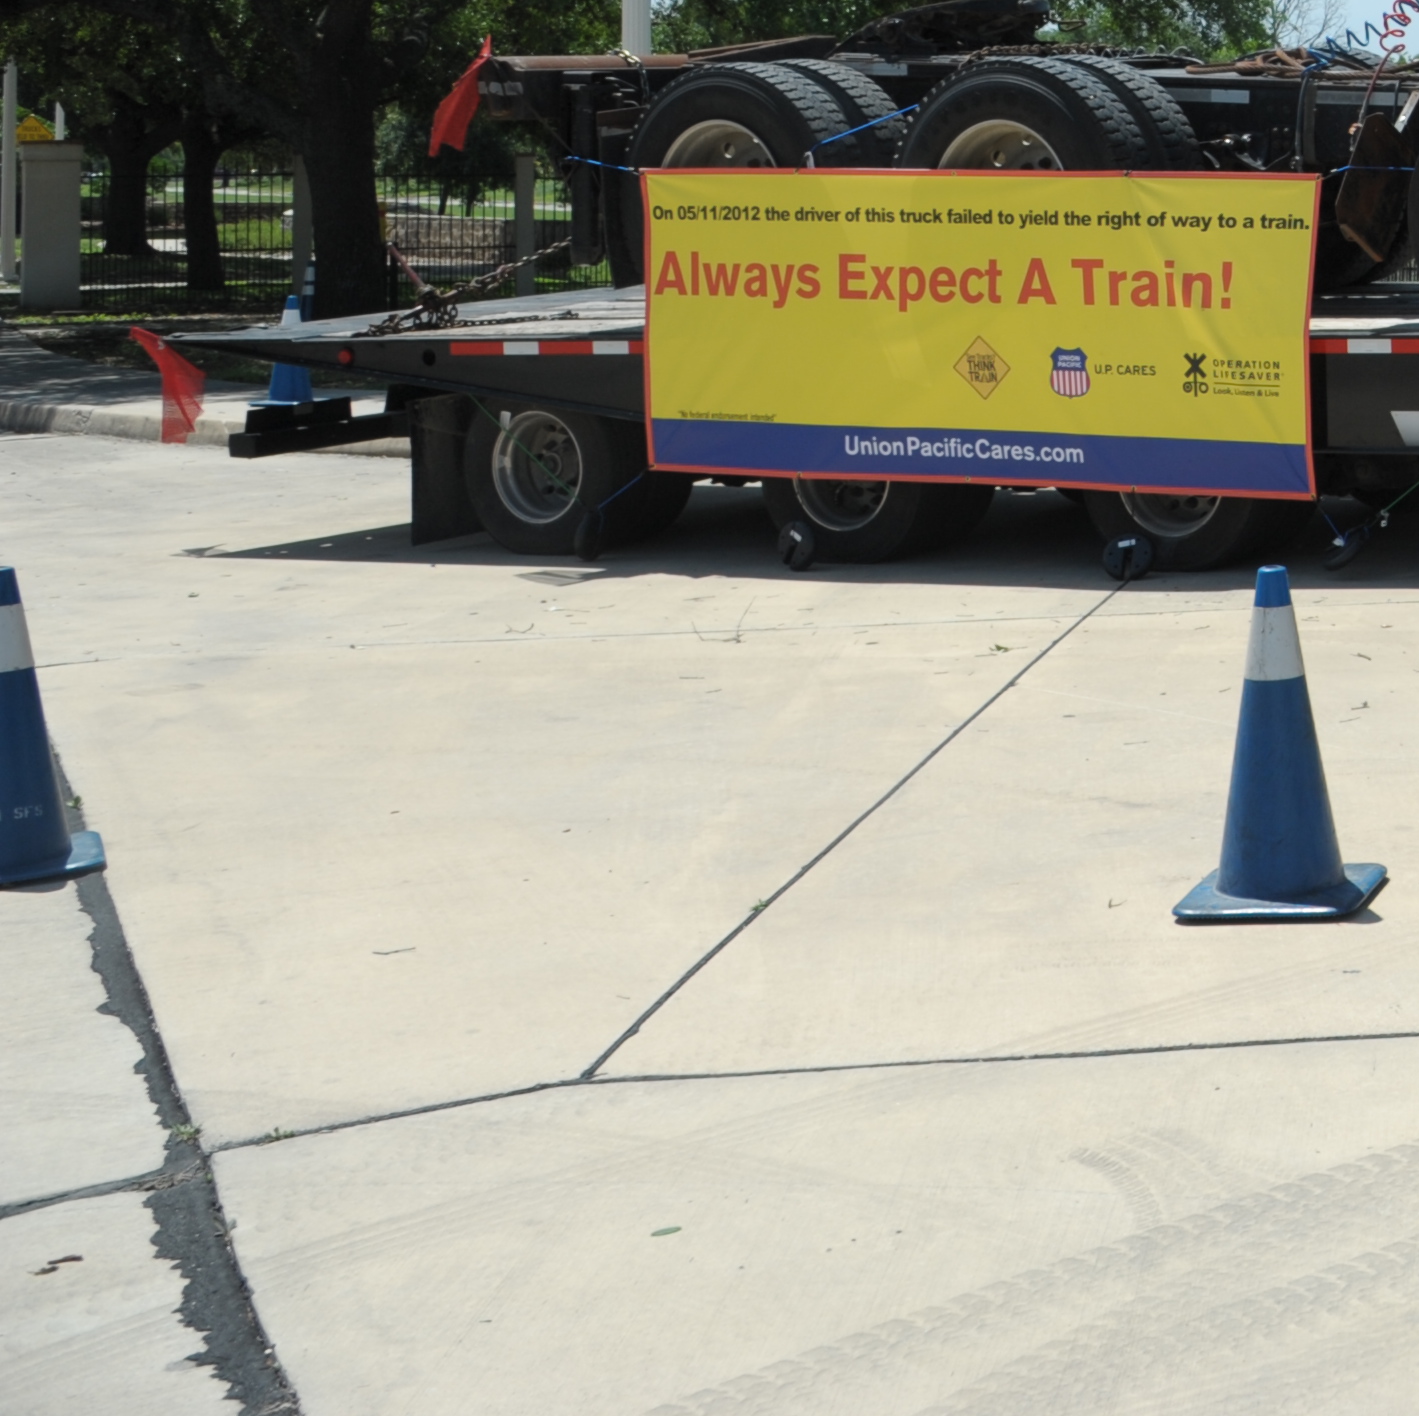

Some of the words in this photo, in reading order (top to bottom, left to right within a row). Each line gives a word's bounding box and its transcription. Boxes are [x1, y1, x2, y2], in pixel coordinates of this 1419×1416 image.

[653, 206, 673, 221] On
[677, 206, 761, 221] 05/11/2012
[765, 206, 790, 221] the
[794, 207, 840, 222] driver
[845, 207, 861, 222] of
[865, 208, 895, 223] this
[899, 208, 943, 224] truck
[947, 208, 992, 224] failed
[998, 210, 1014, 224] to
[1019, 210, 1058, 229] yield
[1064, 210, 1091, 226] the
[1097, 211, 1141, 230] right
[1147, 212, 1167, 227] of
[1172, 214, 1212, 231] way
[1218, 213, 1237, 228] to
[1243, 217, 1254, 229] a
[1260, 214, 1310, 230] train.
[654, 250, 821, 309] Always
[838, 253, 1002, 313] Expect
[1017, 257, 1057, 305] A
[1071, 258, 1233, 309] Train!
[967, 360, 996, 371] THINK
[1094, 364, 1113, 375] U.P.
[1116, 365, 1156, 376] CARES
[1212, 359, 1280, 369] OPERATION
[968, 371, 998, 383] TRAIN
[1213, 370, 1281, 380] LIFESAVER
[1213, 387, 1233, 395] Look,
[844, 435, 1085, 464] UnionPacificCares.com
